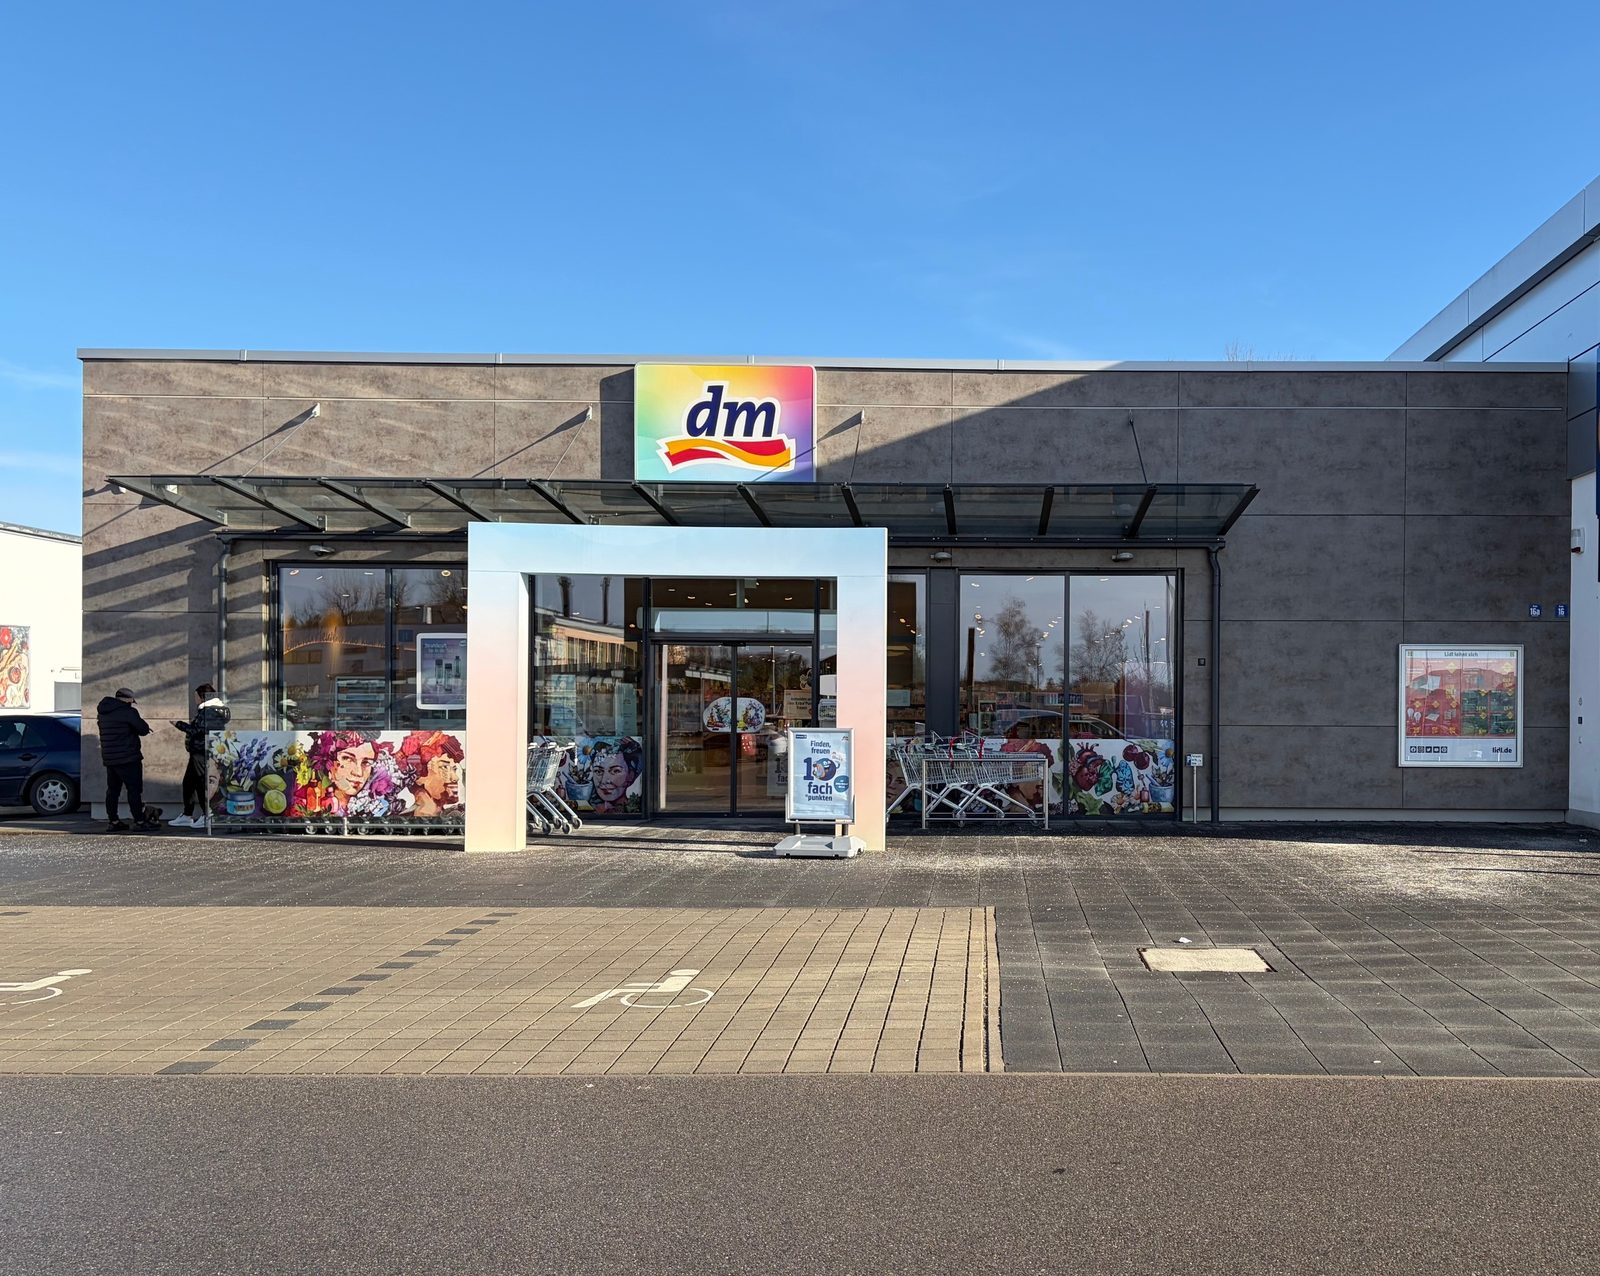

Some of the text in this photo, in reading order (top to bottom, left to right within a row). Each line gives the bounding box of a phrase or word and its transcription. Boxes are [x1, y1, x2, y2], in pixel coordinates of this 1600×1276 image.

[686, 385, 776, 438] dm
[1558, 607, 1565, 616] 16
[810, 740, 832, 748] Finden,
[811, 747, 831, 755] freuen
[1492, 746, 1513, 754] lidl.de
[807, 781, 833, 795] fach
